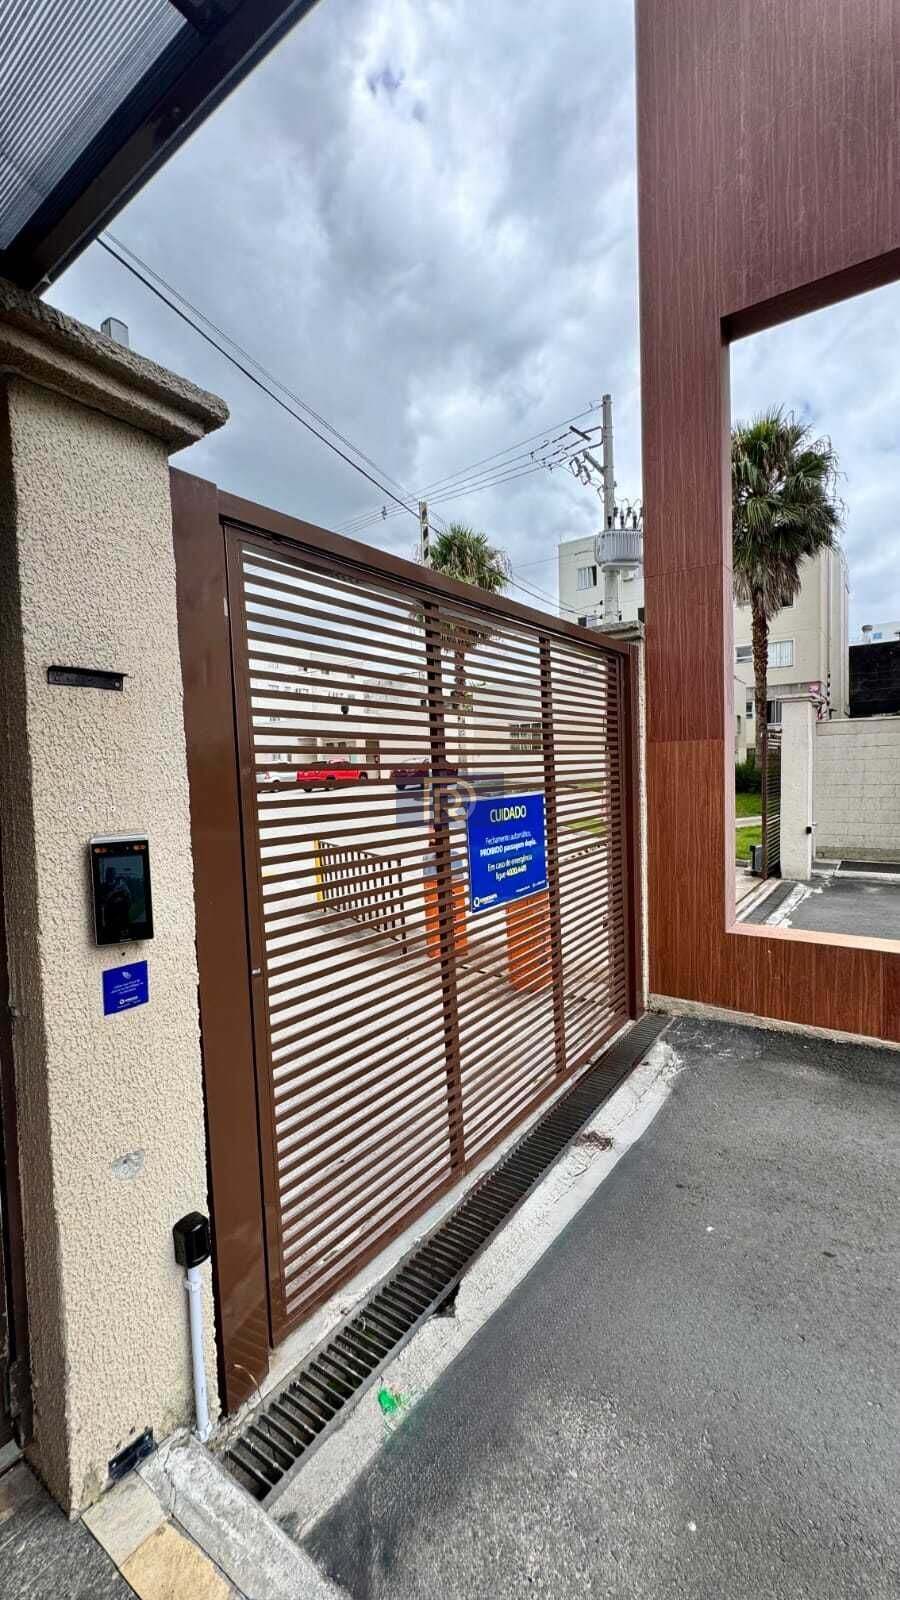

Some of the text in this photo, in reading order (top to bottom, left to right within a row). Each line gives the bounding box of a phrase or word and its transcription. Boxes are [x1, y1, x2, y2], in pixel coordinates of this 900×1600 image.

[490, 804, 527, 823] CUIDADO
[480, 845, 503, 857] PROIBIDO
[504, 842, 524, 853] passagem
[488, 863, 495, 872] Em
[496, 861, 505, 869] caso
[506, 858, 511, 867] de
[495, 871, 506, 881] ligue
